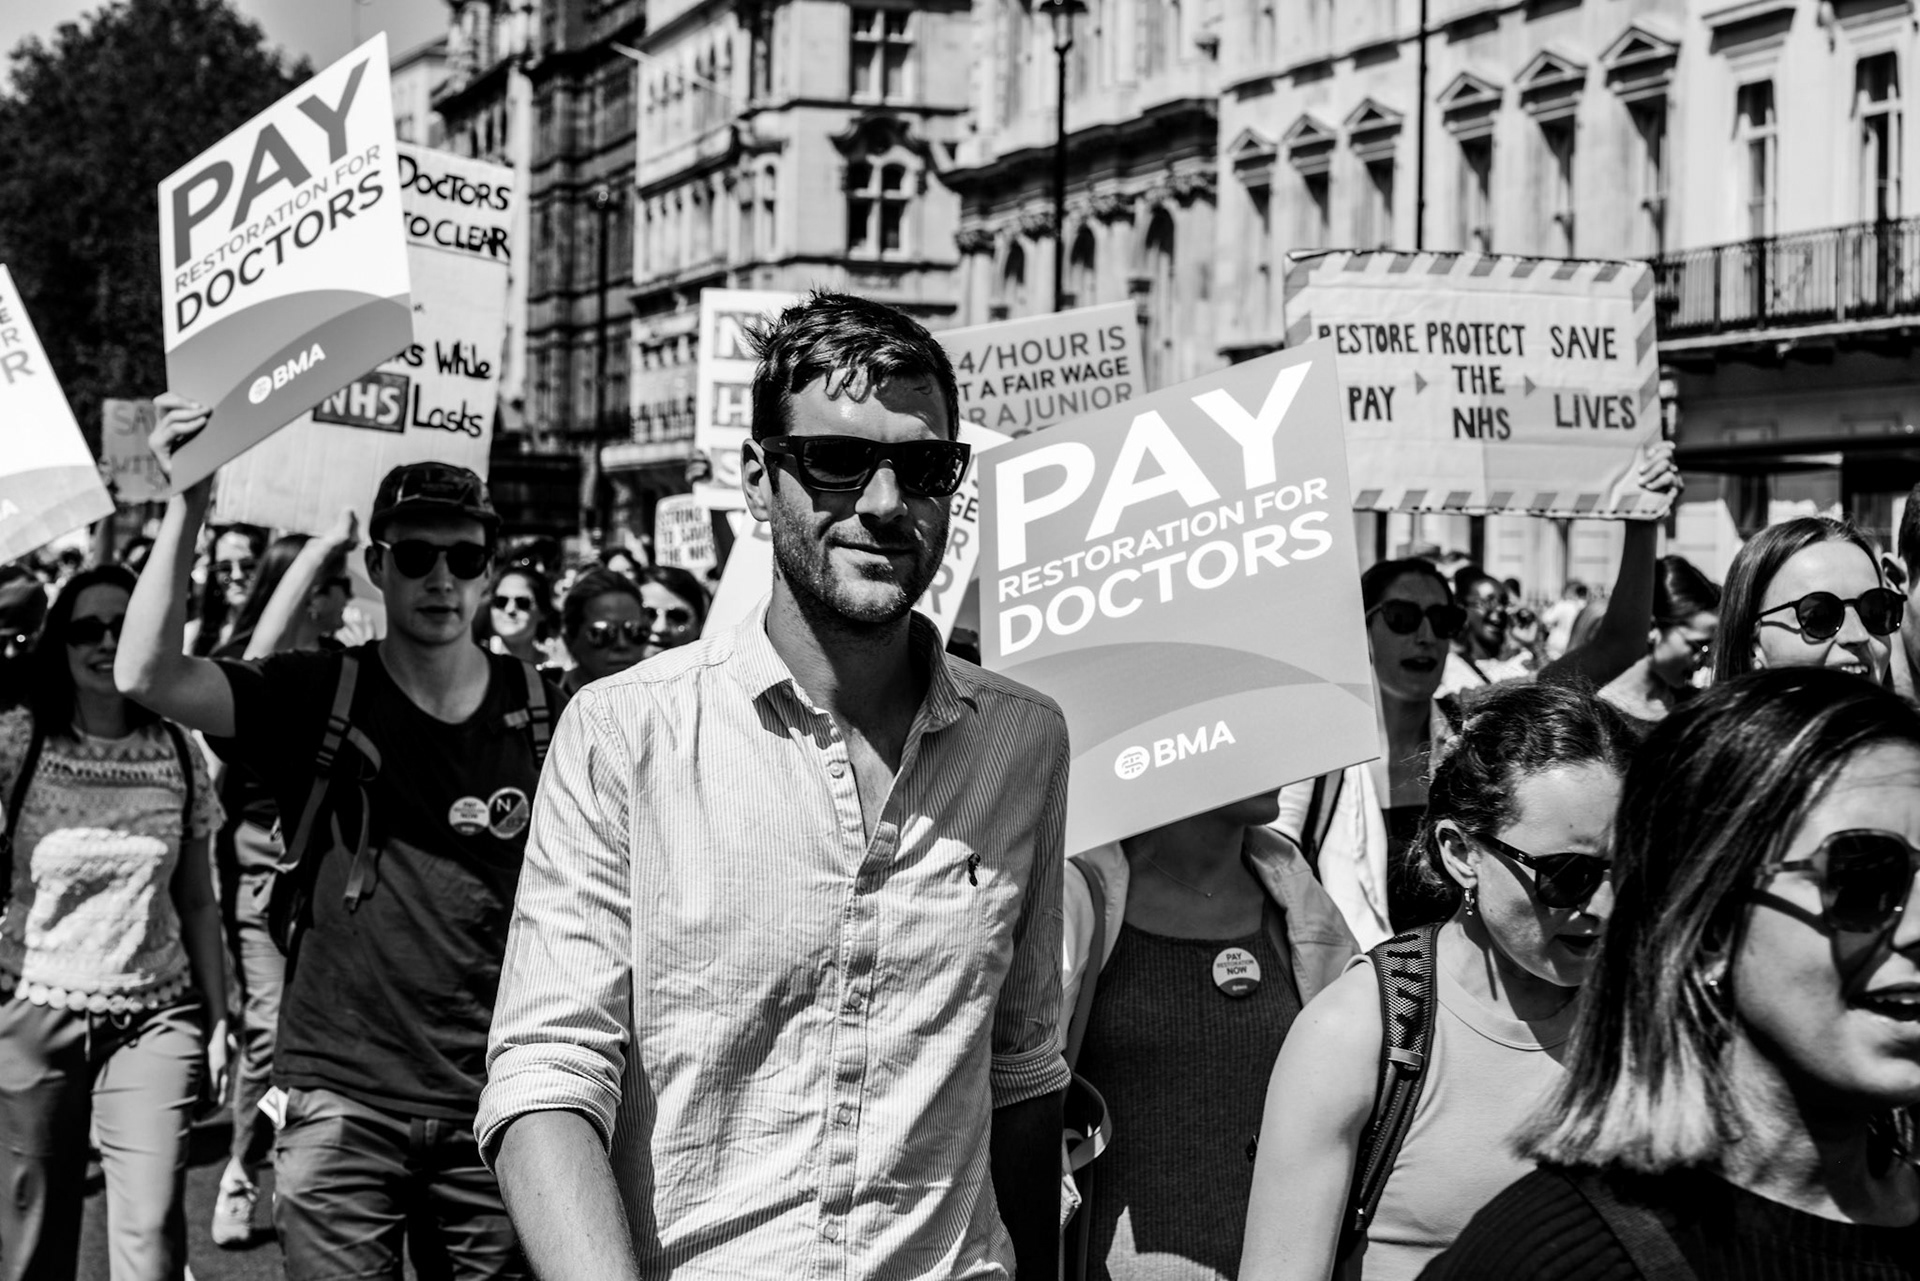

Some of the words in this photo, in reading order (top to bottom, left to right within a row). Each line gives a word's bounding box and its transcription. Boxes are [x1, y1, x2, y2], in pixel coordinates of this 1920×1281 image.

[172, 57, 370, 269] PAY
[175, 177, 328, 293] RESTORATION
[335, 145, 380, 185] FOR
[434, 220, 510, 259] CLEAR
[176, 170, 383, 333] DOCTORS
[1098, 326, 1126, 352] IS
[1427, 322, 1525, 356] PROTECT
[1550, 326, 1617, 359] SAVE
[273, 343, 326, 390] BMA
[980, 381, 996, 399] A
[1003, 370, 1055, 395] FAIR
[1060, 356, 1131, 385] WAGE
[1452, 365, 1505, 394] THE
[321, 382, 401, 424] NHS
[412, 383, 483, 437] Lasts
[998, 404, 1016, 427] A
[1024, 382, 1133, 427] JUNIOR
[1347, 386, 1395, 422] PAY
[1453, 407, 1511, 440] NHS
[1554, 394, 1636, 429] LIVES
[996, 361, 1313, 571] PAY
[998, 501, 1245, 603] RESTORATION
[1254, 477, 1329, 519] FOR
[999, 511, 1333, 657] DOCTORS
[1153, 720, 1236, 768] BMA
[496, 798, 511, 812] N
[1226, 953, 1241, 961] PAY
[1226, 966, 1246, 975] NOW
